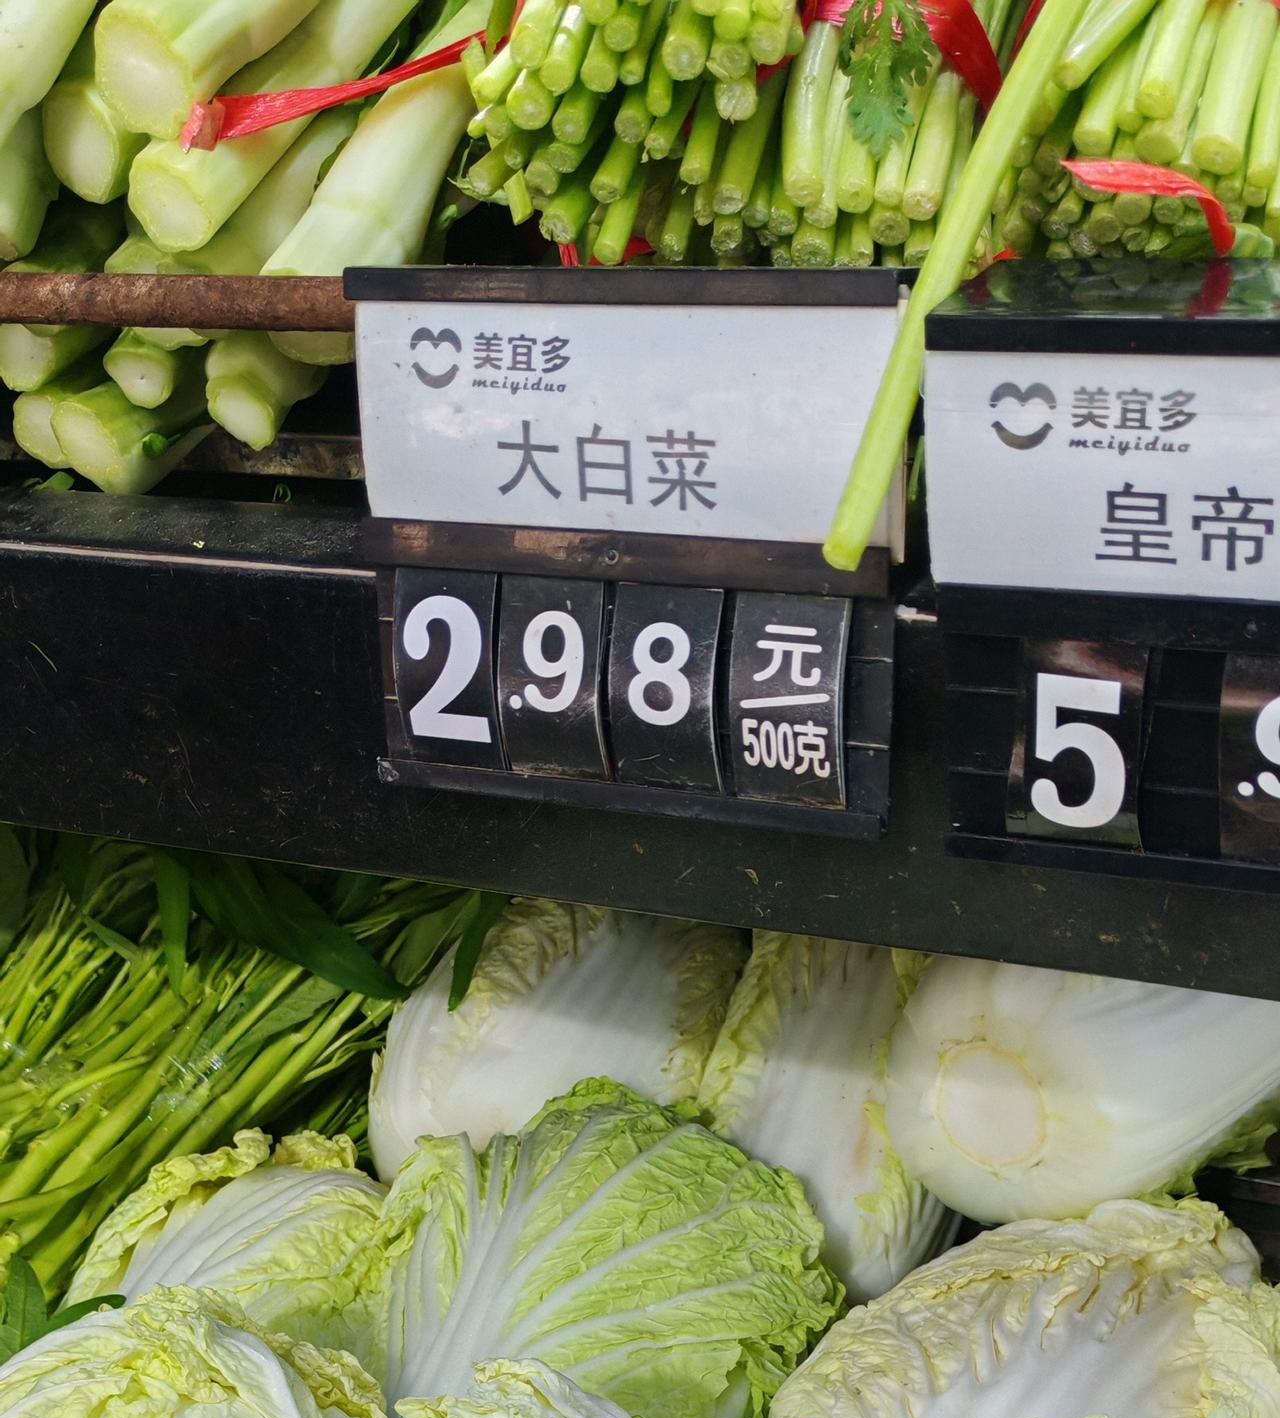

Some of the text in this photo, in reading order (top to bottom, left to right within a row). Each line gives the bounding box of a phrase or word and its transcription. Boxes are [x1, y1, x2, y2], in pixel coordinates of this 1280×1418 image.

[472, 331, 572, 374] 美宜多
[471, 376, 568, 395] meiyiduo
[1071, 385, 1199, 432] 美宜多
[497, 419, 718, 512] 大白菜
[1069, 435, 1193, 456] meiyiduo
[1095, 482, 1275, 572] 皇帝
[402, 594, 692, 744] 2.98
[740, 718, 831, 779] 500克
